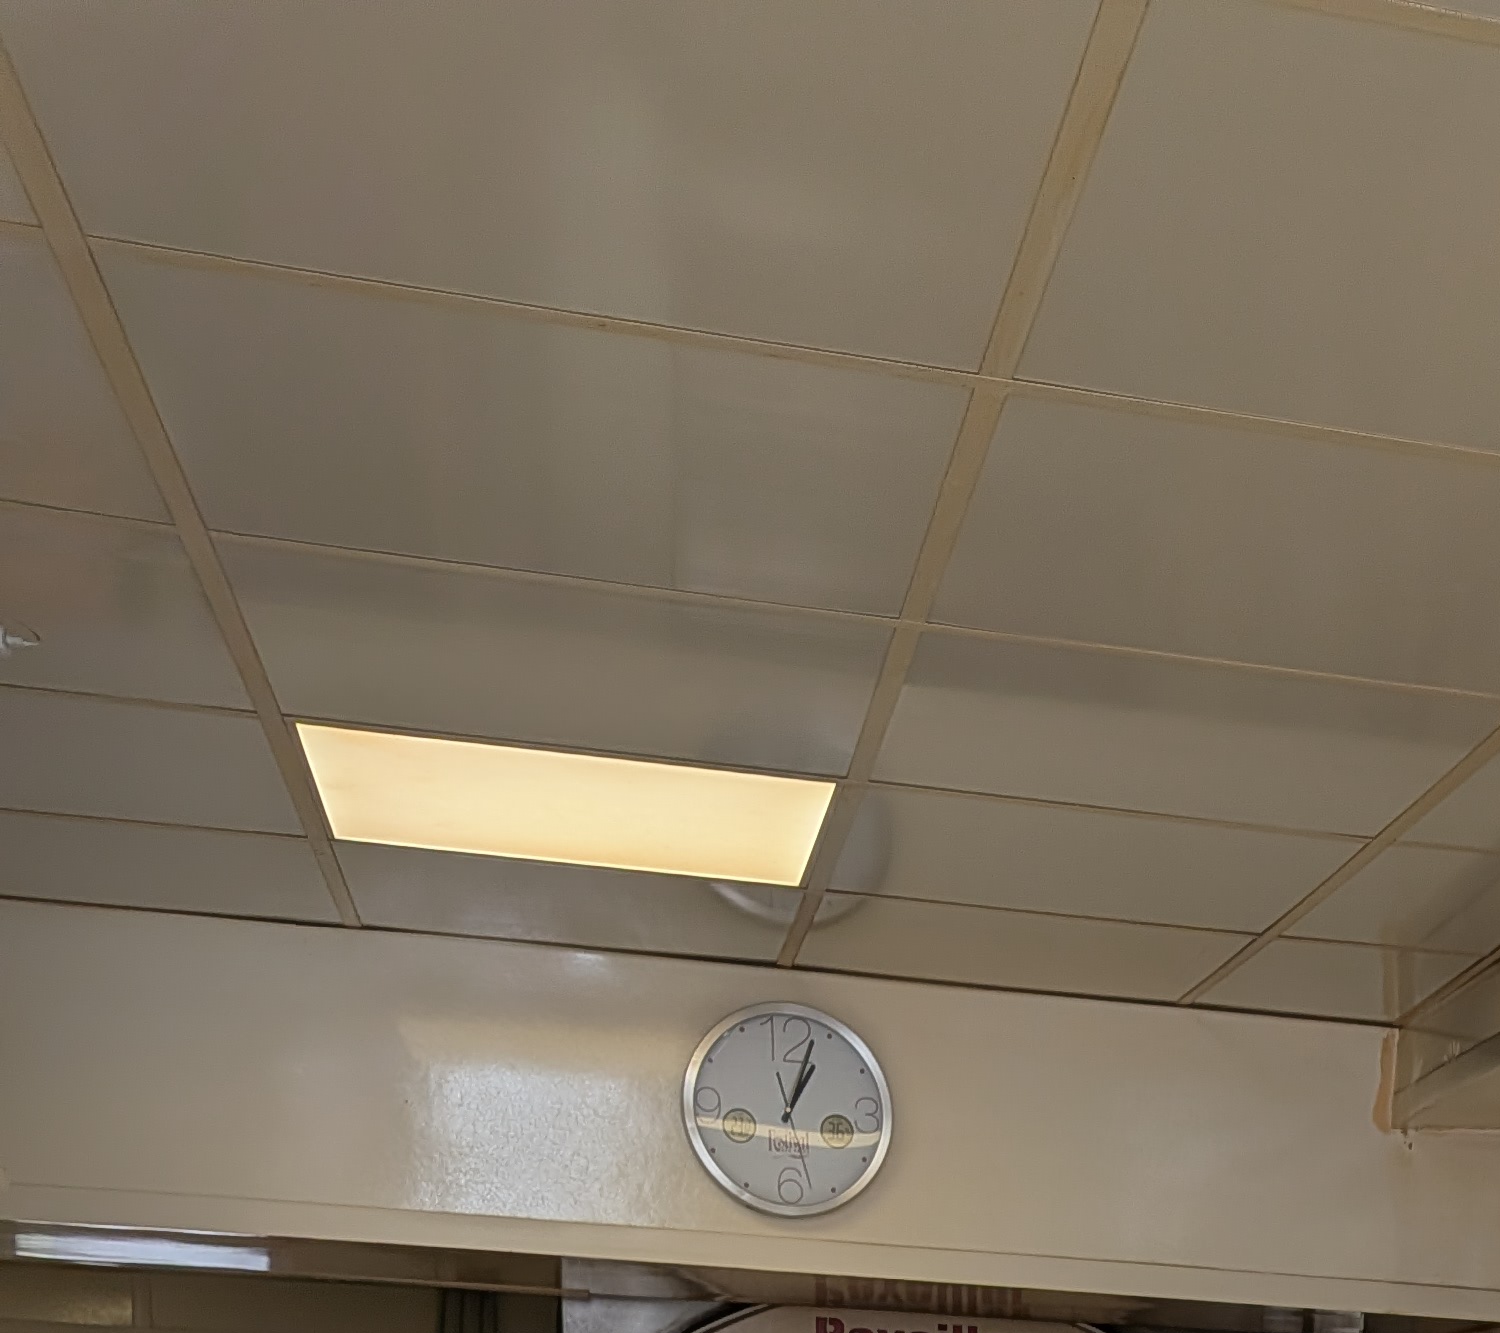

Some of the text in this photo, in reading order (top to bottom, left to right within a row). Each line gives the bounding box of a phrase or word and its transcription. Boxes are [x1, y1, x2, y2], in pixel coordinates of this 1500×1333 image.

[760, 1015, 814, 1065] 12
[696, 1086, 721, 1119] 9
[855, 1097, 880, 1134] 3
[778, 1167, 803, 1204] 6
